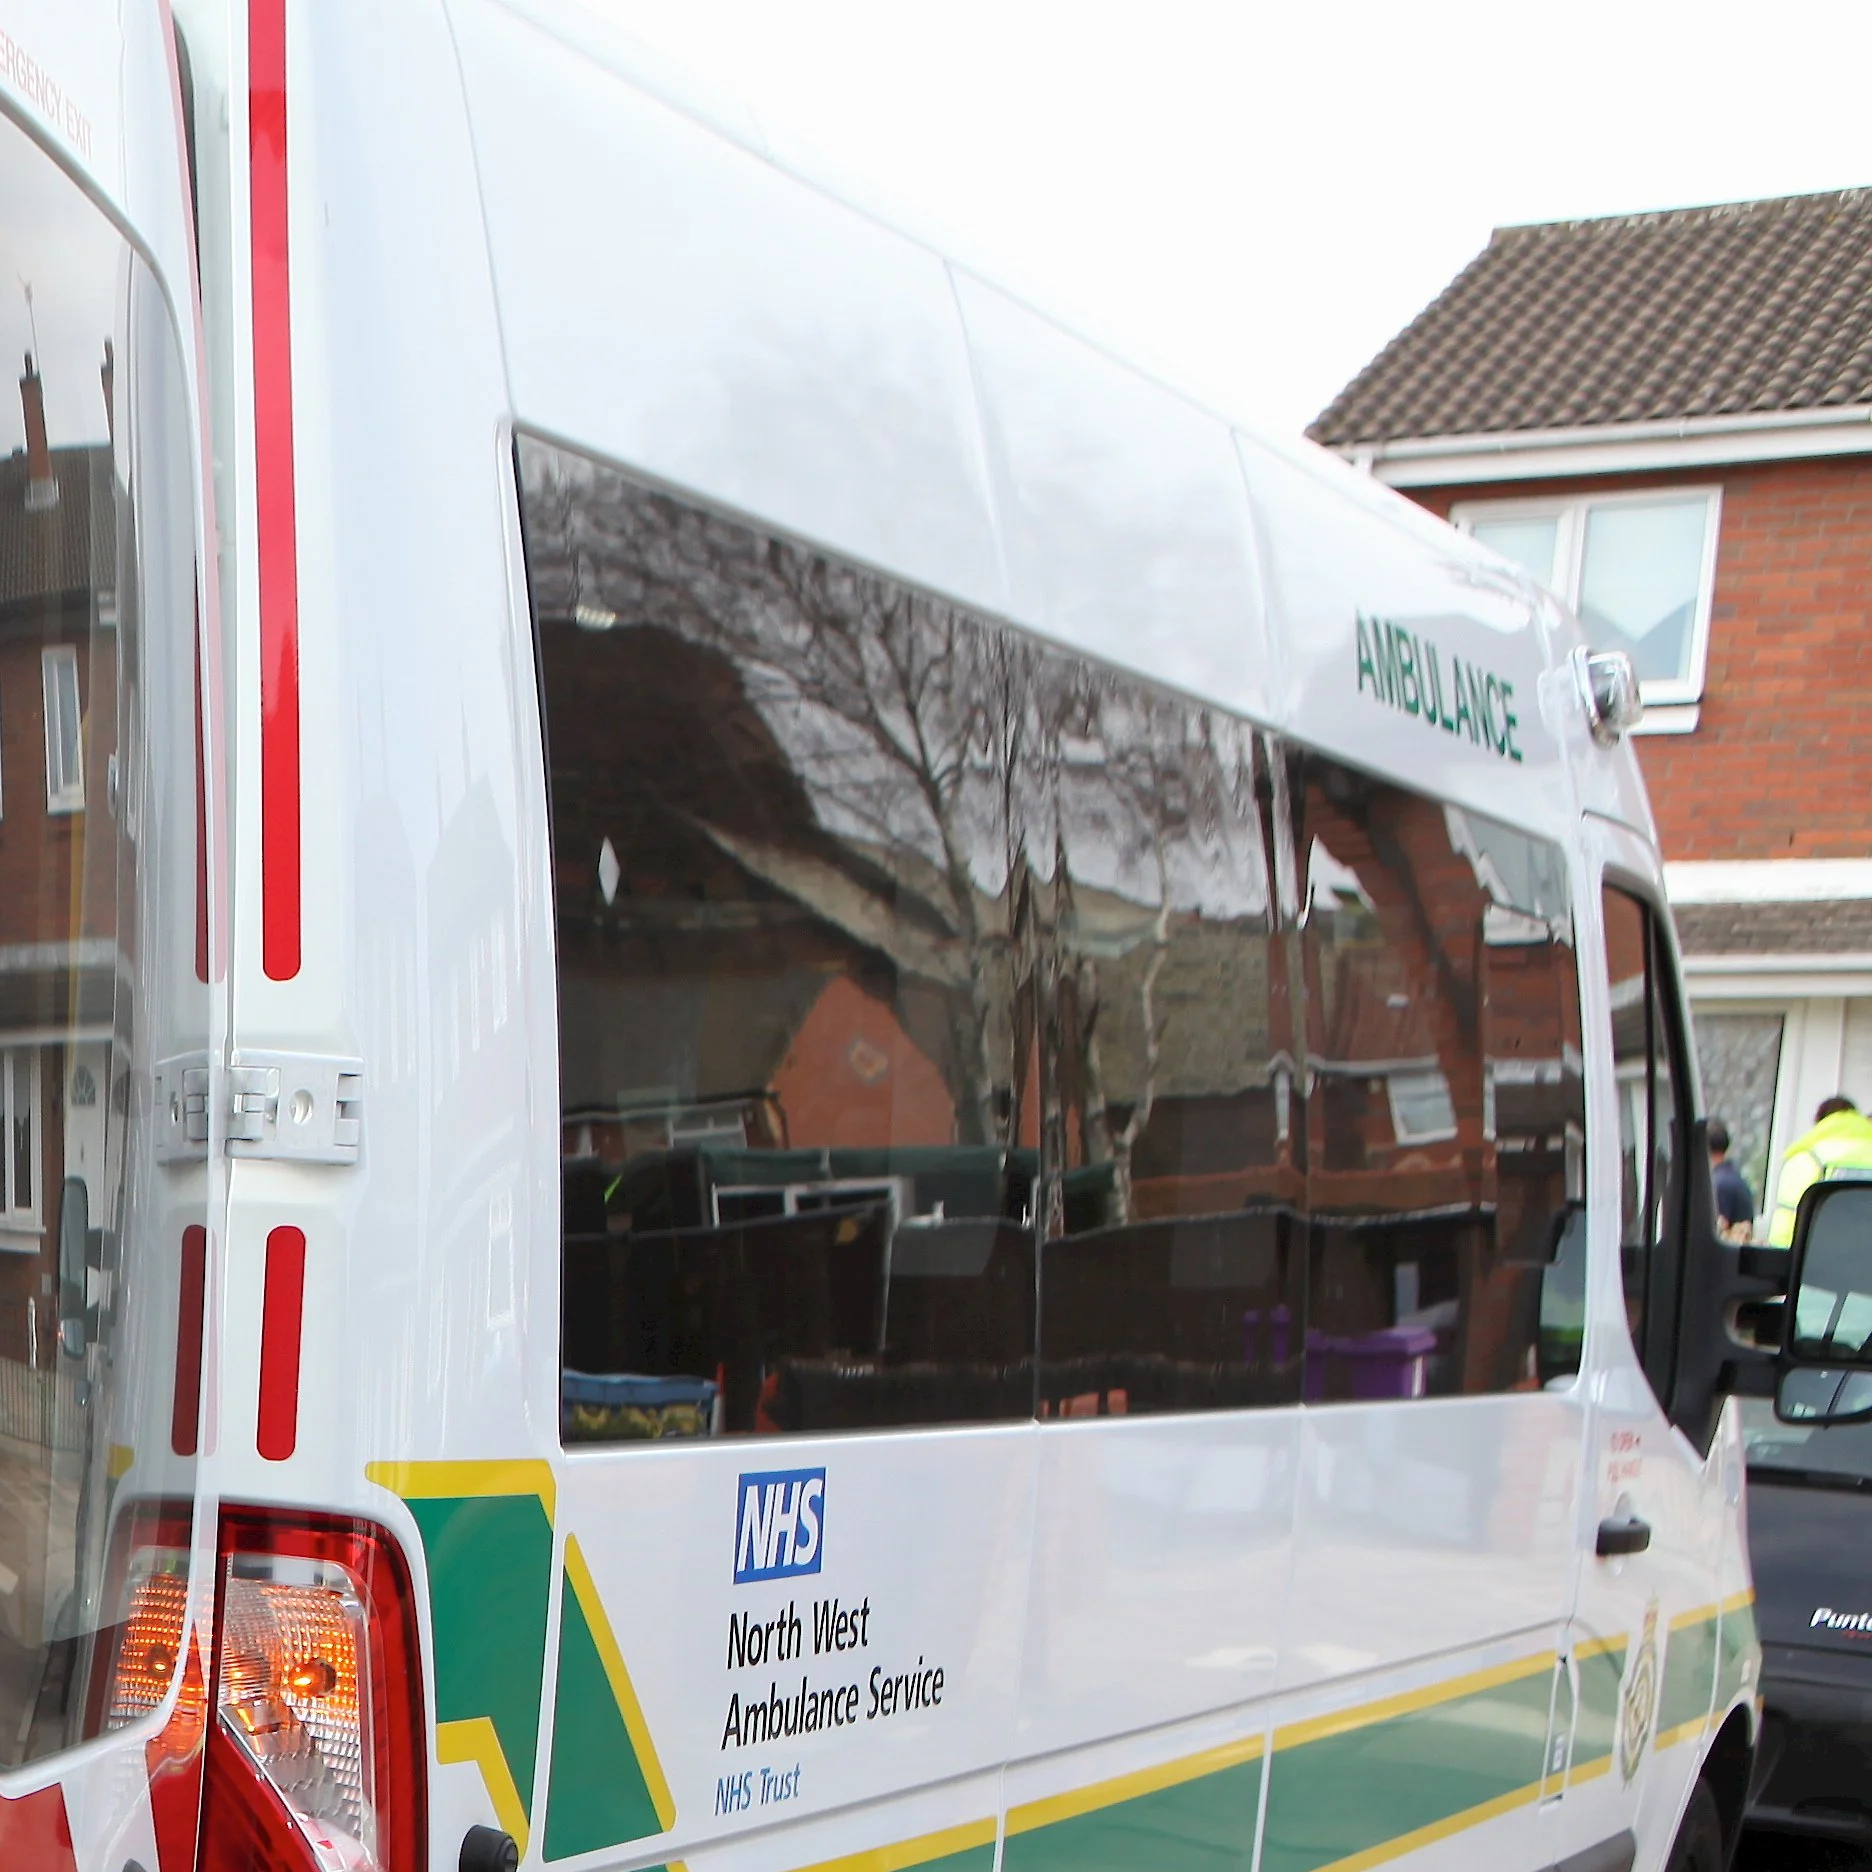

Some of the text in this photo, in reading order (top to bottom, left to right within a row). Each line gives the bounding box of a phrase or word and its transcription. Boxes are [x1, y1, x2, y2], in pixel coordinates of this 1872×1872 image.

[65, 96, 93, 163] EXIT
[1356, 608, 1523, 765] AMBULANCE
[736, 1478, 823, 1573] NHS
[727, 1596, 871, 1670] North West
[720, 1655, 944, 1750] Ambulance Service
[714, 1762, 801, 1816] NHS Trust
